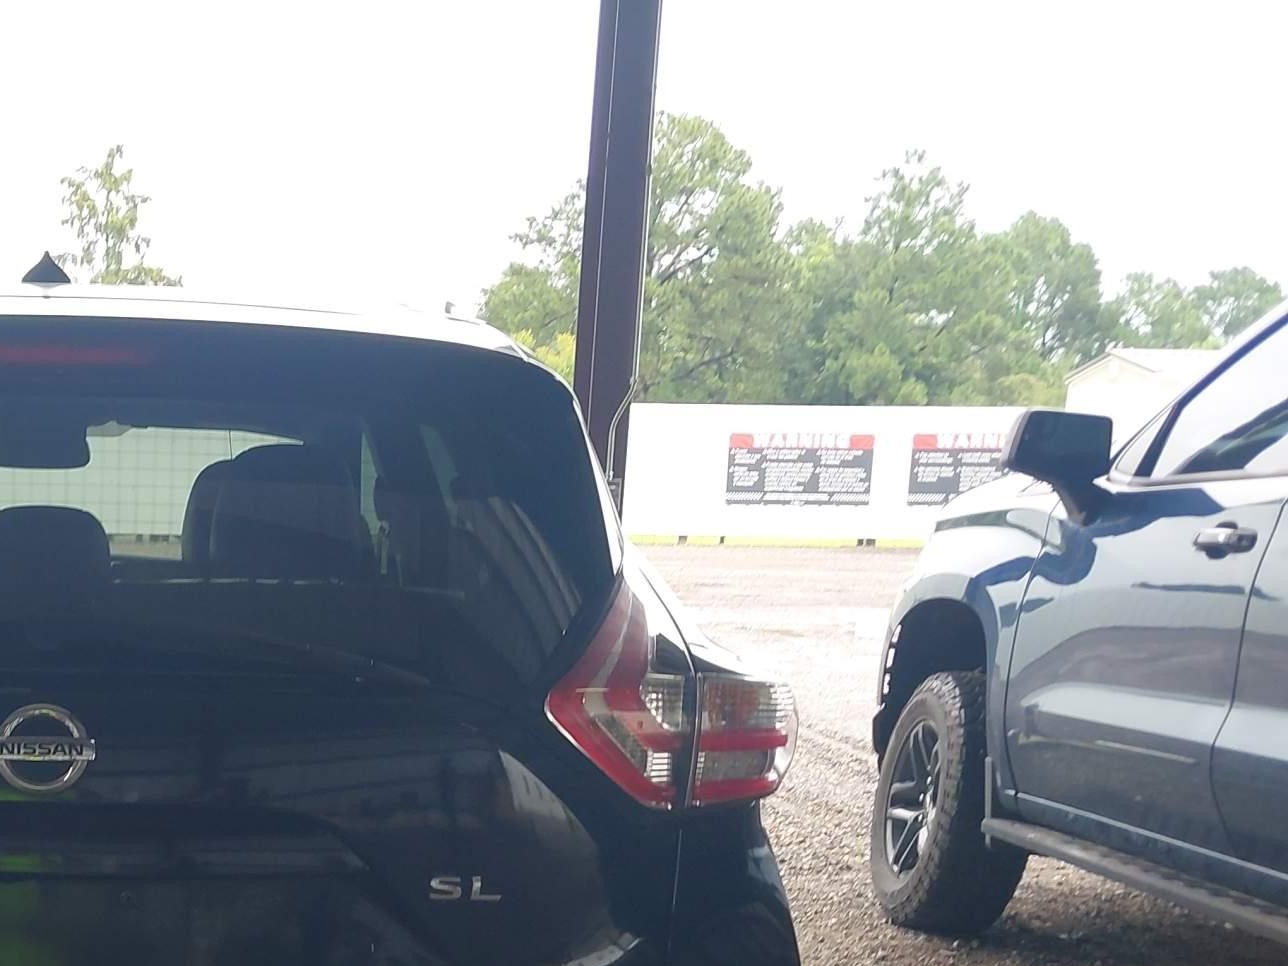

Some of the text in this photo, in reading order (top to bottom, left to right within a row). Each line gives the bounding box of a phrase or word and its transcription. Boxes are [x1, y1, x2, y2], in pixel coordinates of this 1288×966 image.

[752, 432, 850, 449] WARNING
[0, 742, 83, 756] NISSAN
[429, 875, 502, 901] SL
